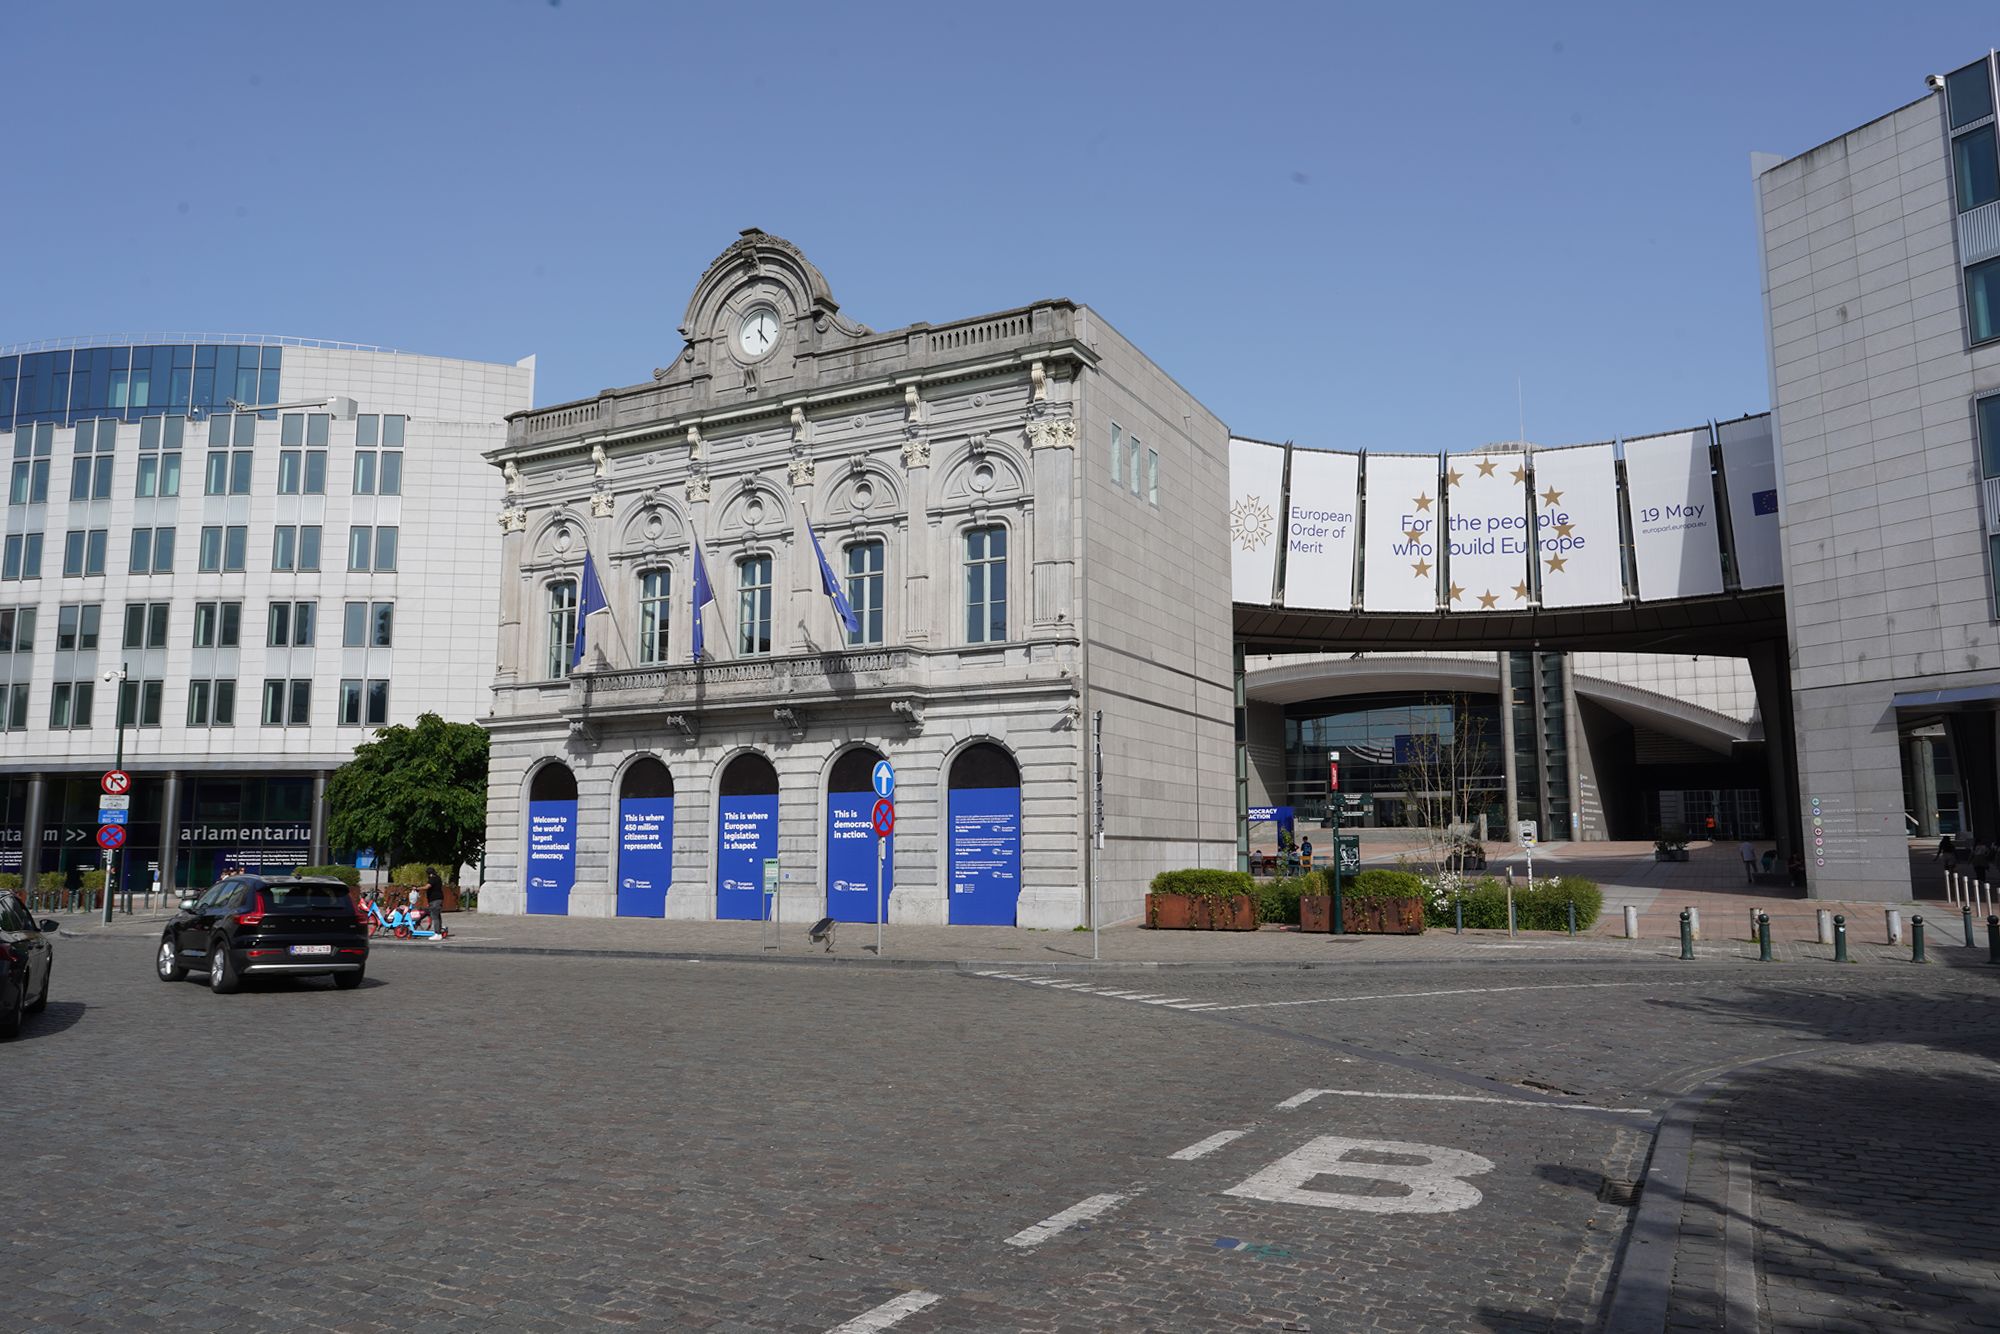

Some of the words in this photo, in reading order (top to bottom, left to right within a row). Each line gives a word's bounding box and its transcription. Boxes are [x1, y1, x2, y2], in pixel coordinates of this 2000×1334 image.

[1291, 506, 1352, 523] European
[1640, 508, 1660, 522] 19
[1666, 504, 1704, 520] May
[1401, 515, 1432, 532] For
[1449, 514, 1482, 531] the
[1488, 509, 1569, 533] people
[1290, 523, 1329, 537] Order
[1332, 525, 1346, 538] of
[1642, 522, 1707, 534] europarl.europa.eu
[1290, 540, 1324, 554] Merit
[1392, 539, 1432, 556] who
[1448, 537, 1494, 556] build
[1502, 536, 1586, 554] Europe
[624, 814, 638, 822] This
[834, 810, 850, 818] This
[724, 822, 756, 831] European
[834, 821, 874, 830] democracy
[179, 825, 311, 840] arlamentariu
[724, 832, 760, 841] legislation
[532, 835, 553, 843] largest
[624, 842, 663, 851] represented.
[731, 842, 758, 851] shaped.
[532, 852, 564, 861] democracy.
[1223, 1135, 1496, 1214] B
